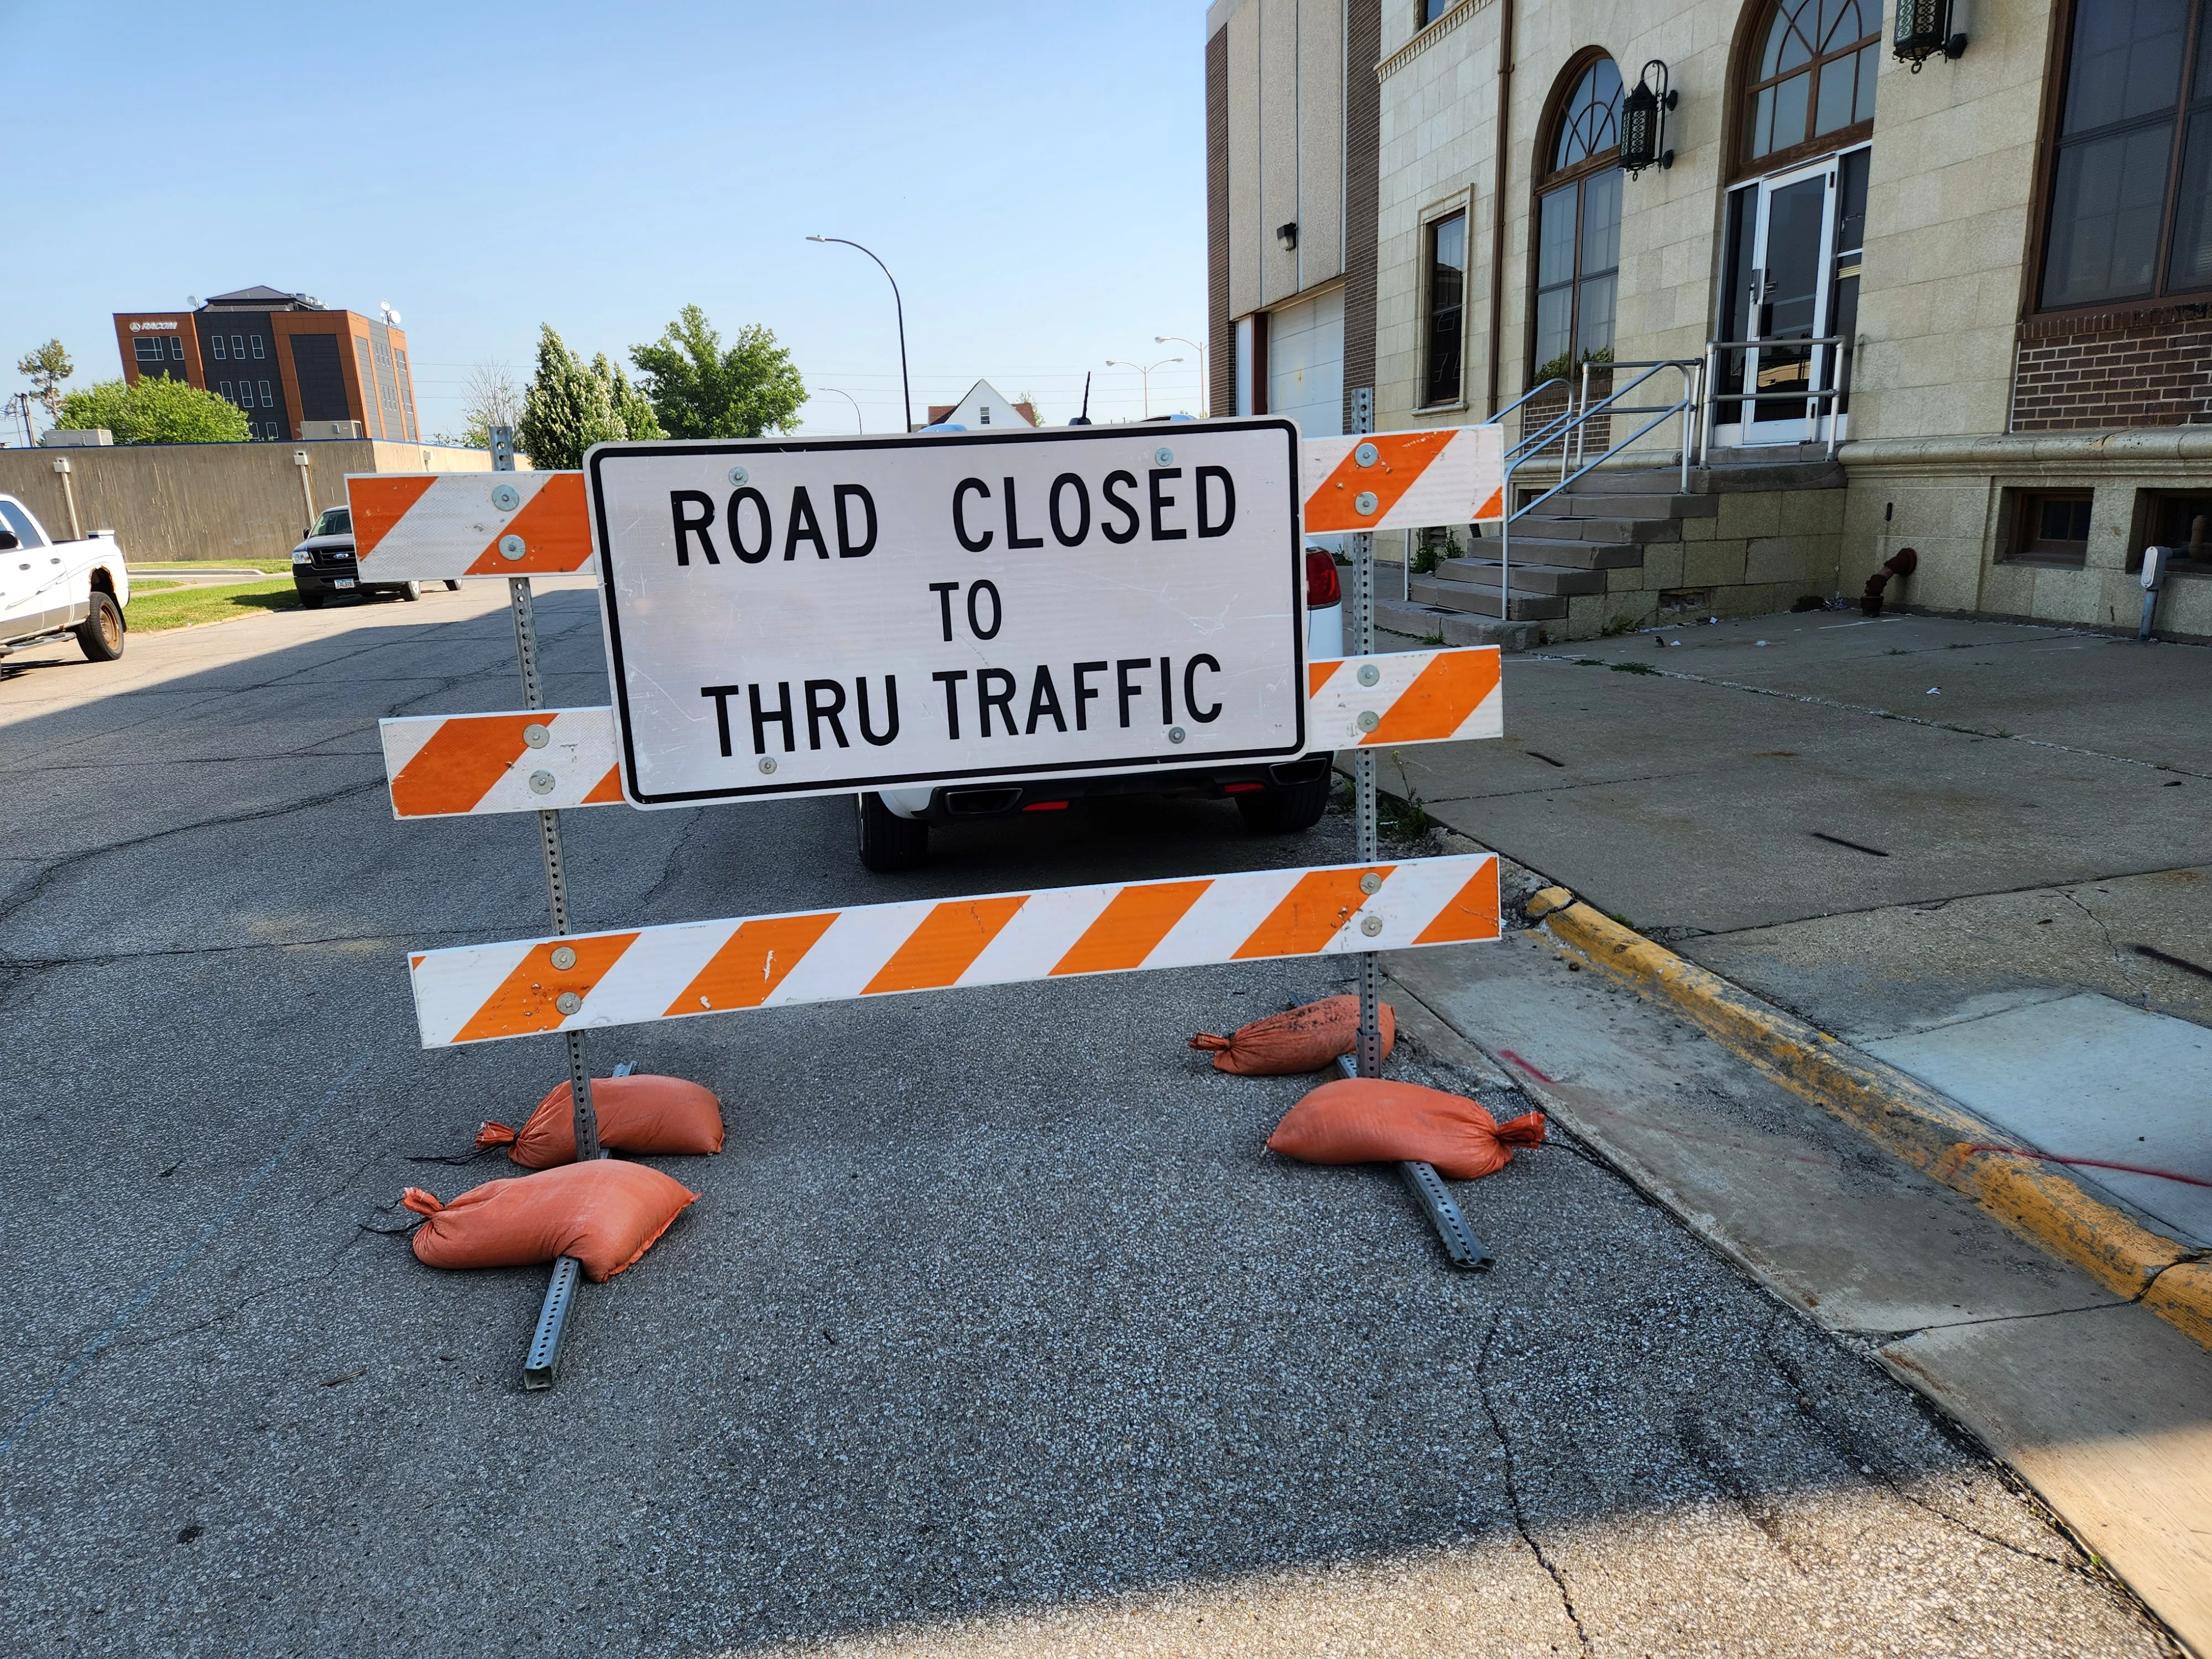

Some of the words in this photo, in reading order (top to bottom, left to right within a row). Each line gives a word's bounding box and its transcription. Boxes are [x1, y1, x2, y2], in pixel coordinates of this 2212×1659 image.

[141, 322, 178, 330] RACOM
[670, 484, 878, 567] ROAD
[952, 465, 1237, 552] CLOSED
[929, 579, 1002, 642] TO
[701, 674, 900, 757] THRU
[932, 653, 1223, 740] TRAFFIC
